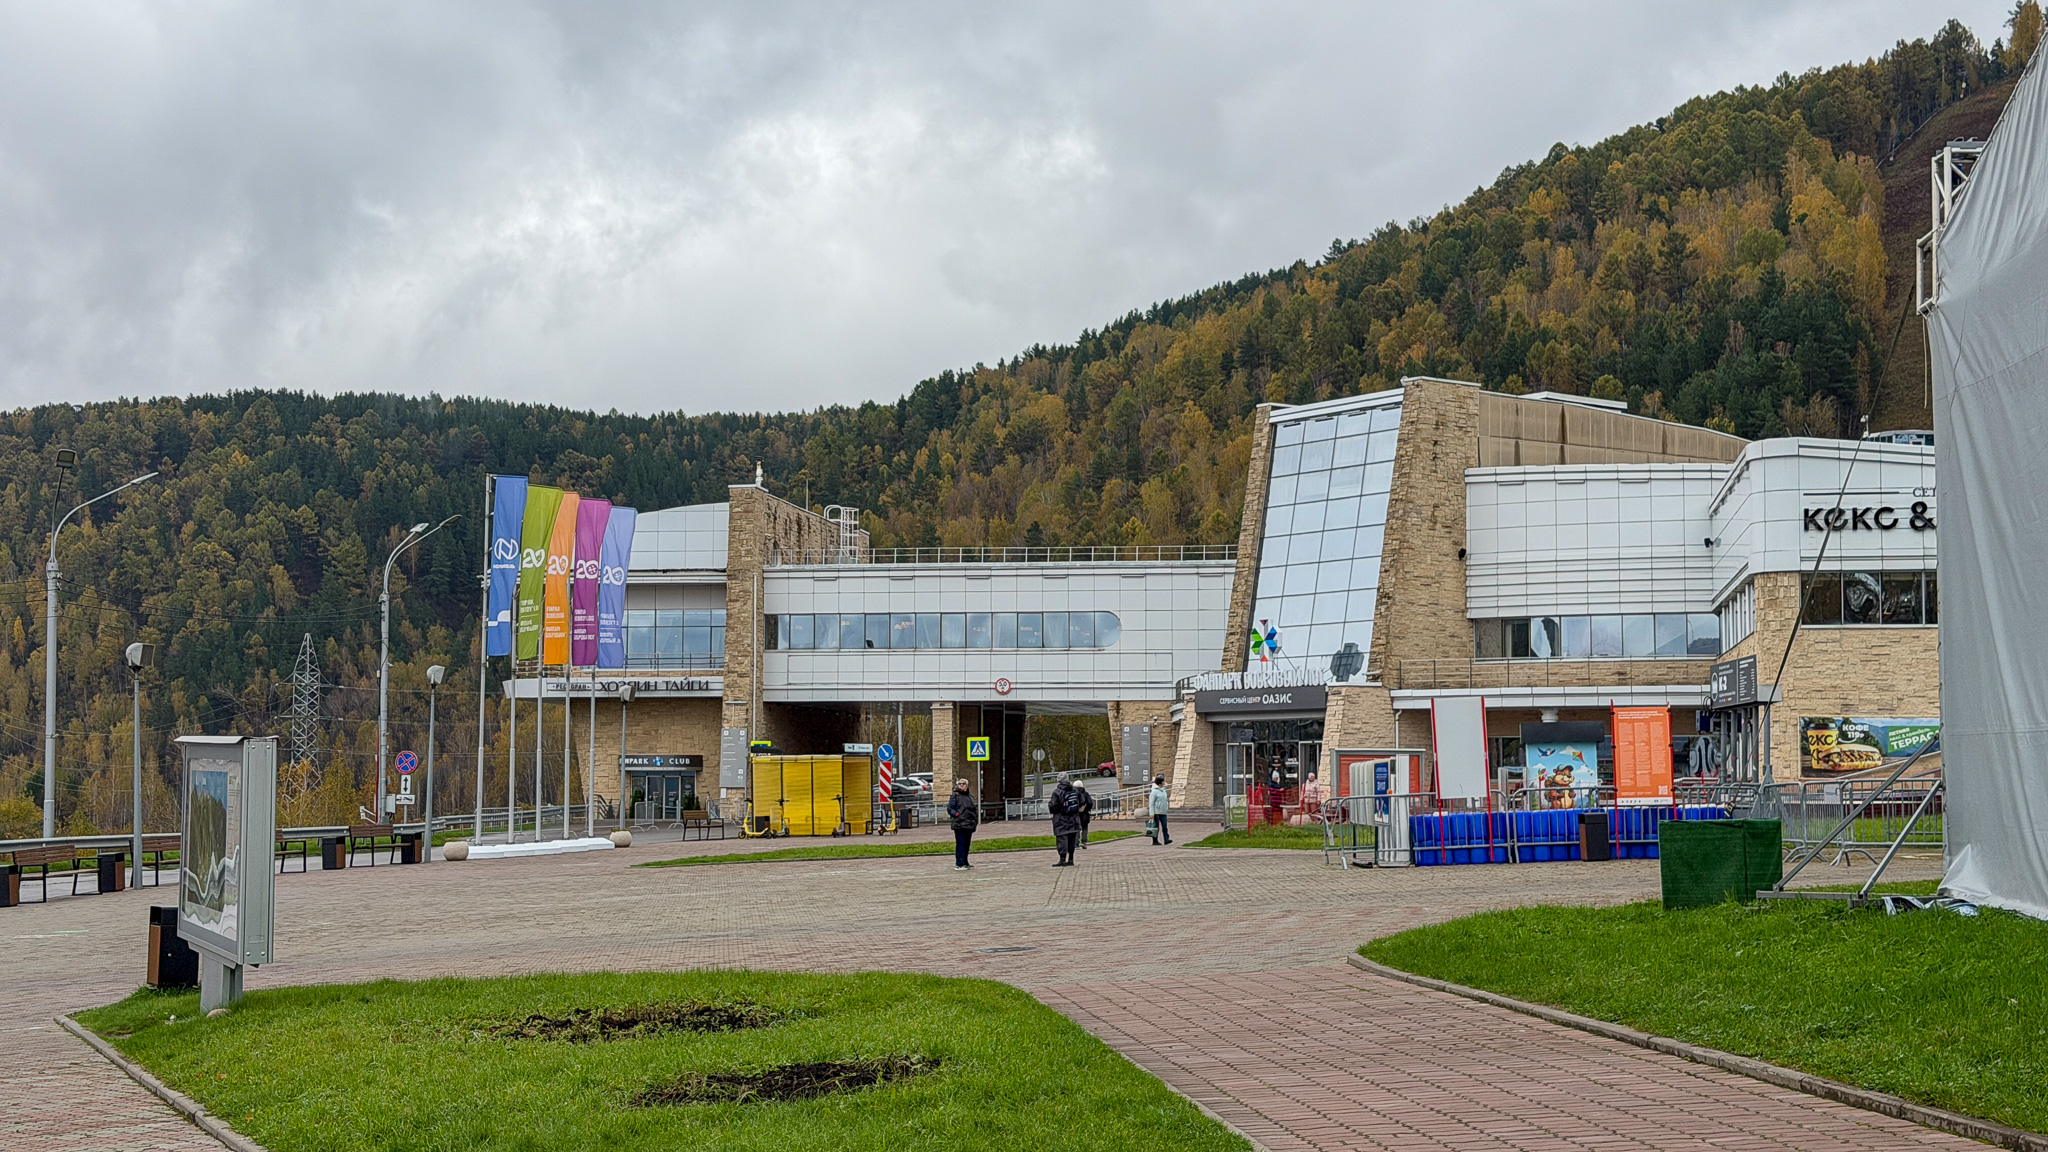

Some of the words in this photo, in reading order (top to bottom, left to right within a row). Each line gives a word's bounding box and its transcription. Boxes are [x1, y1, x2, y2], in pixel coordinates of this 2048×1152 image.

[1909, 501, 1937, 531] &
[522, 548, 546, 569] 20
[547, 554, 569, 576] 20
[575, 559, 599, 580] 20
[602, 565, 625, 586] 20
[662, 677, 709, 691] ТАЙГИ
[1193, 672, 1243, 691] ФАНПАРК
[1262, 693, 1292, 705] ОАЗИС
[1842, 724, 1870, 732] КОФЕ
[619, 758, 649, 766] NPARK
